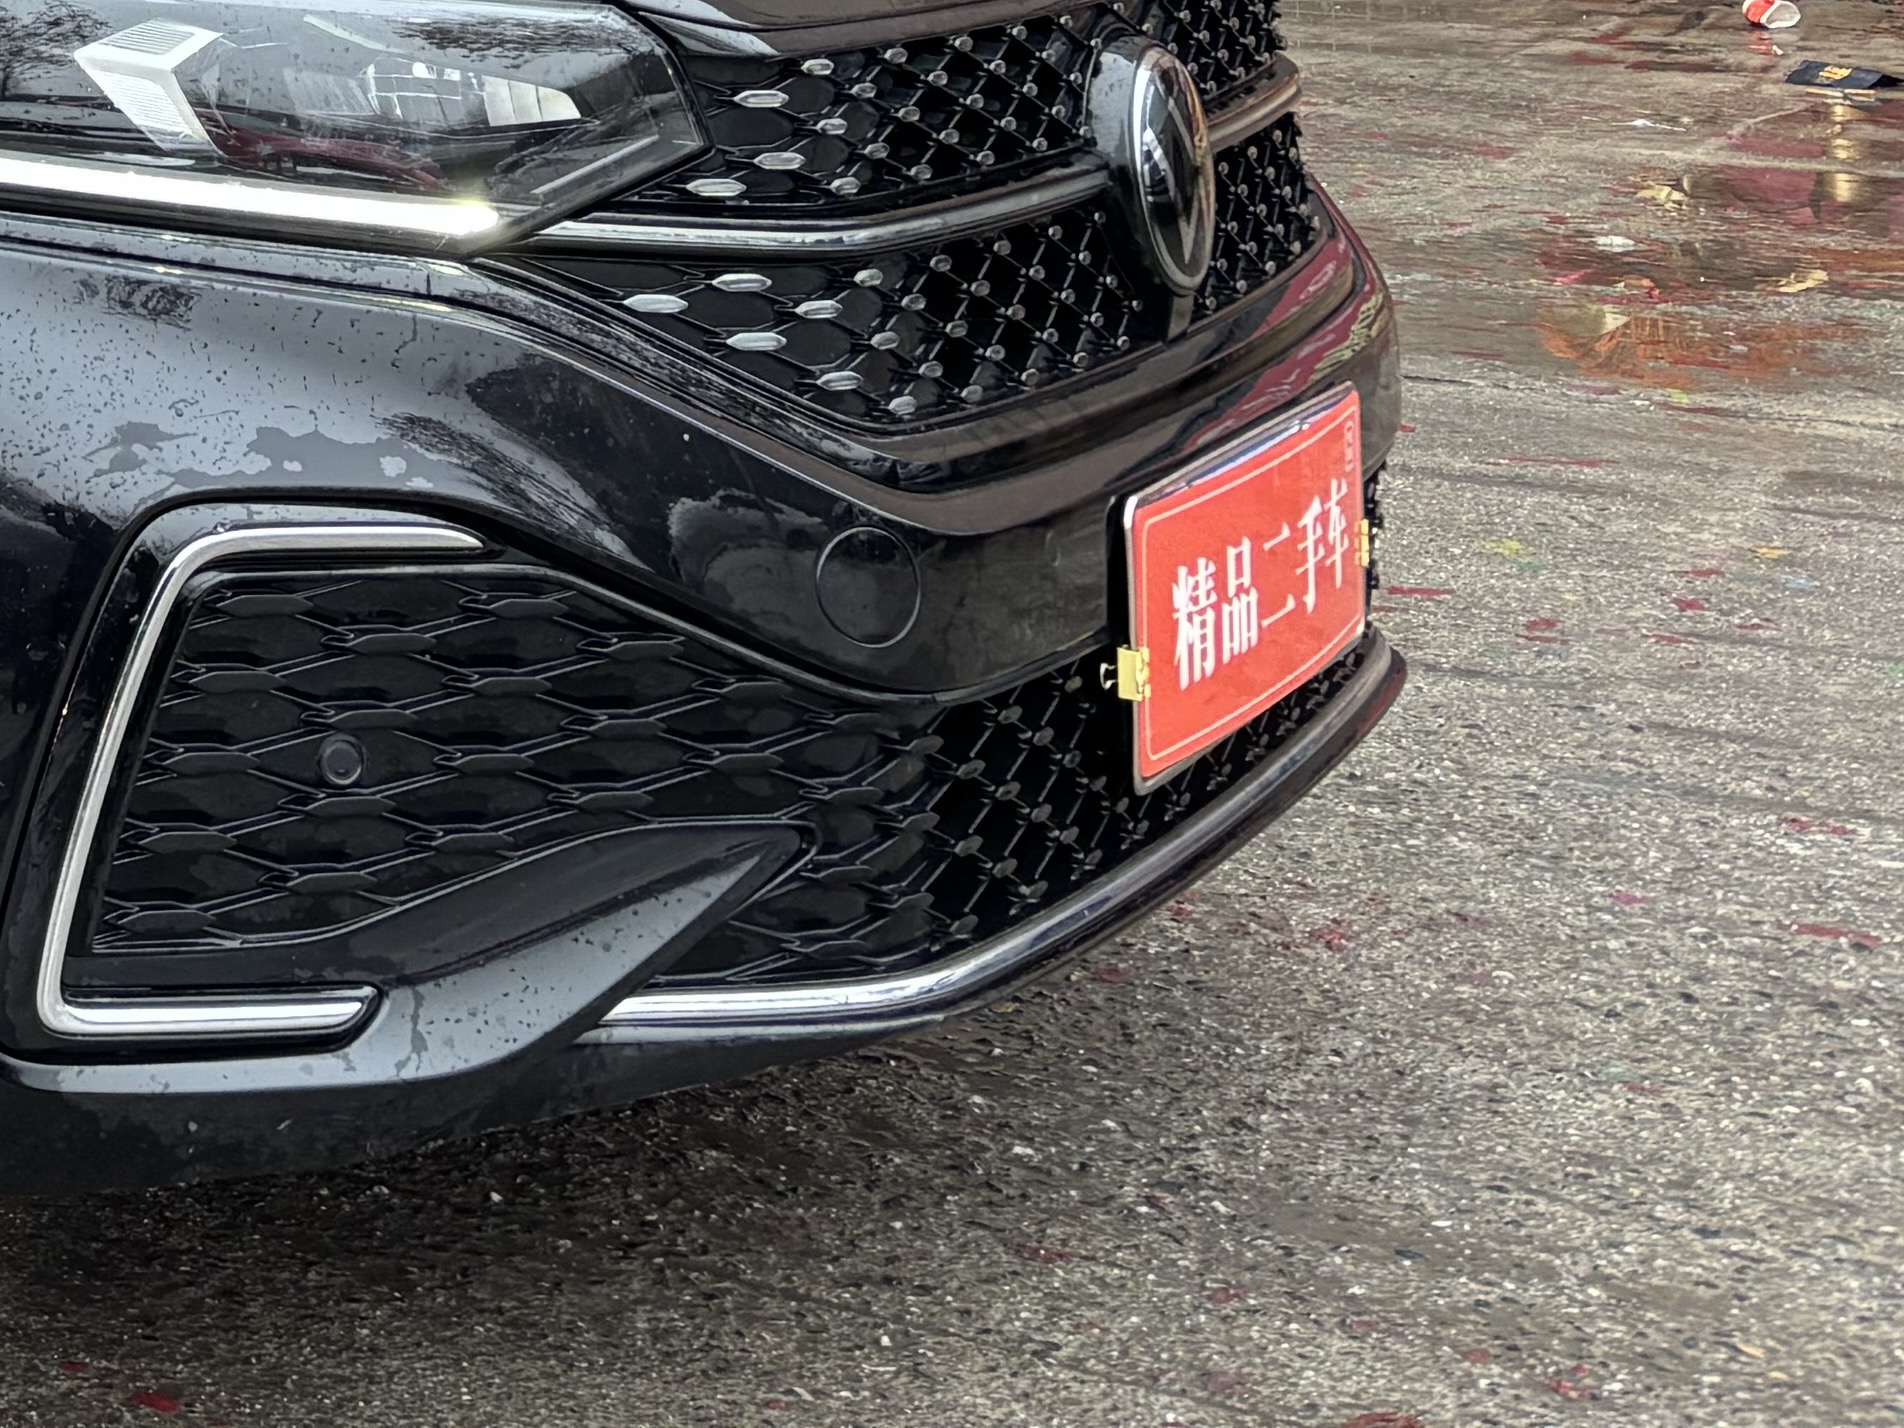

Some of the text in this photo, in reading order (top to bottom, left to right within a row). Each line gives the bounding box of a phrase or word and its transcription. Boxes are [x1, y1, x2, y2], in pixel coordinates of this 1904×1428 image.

[1172, 477, 1350, 691] 精品二手车
